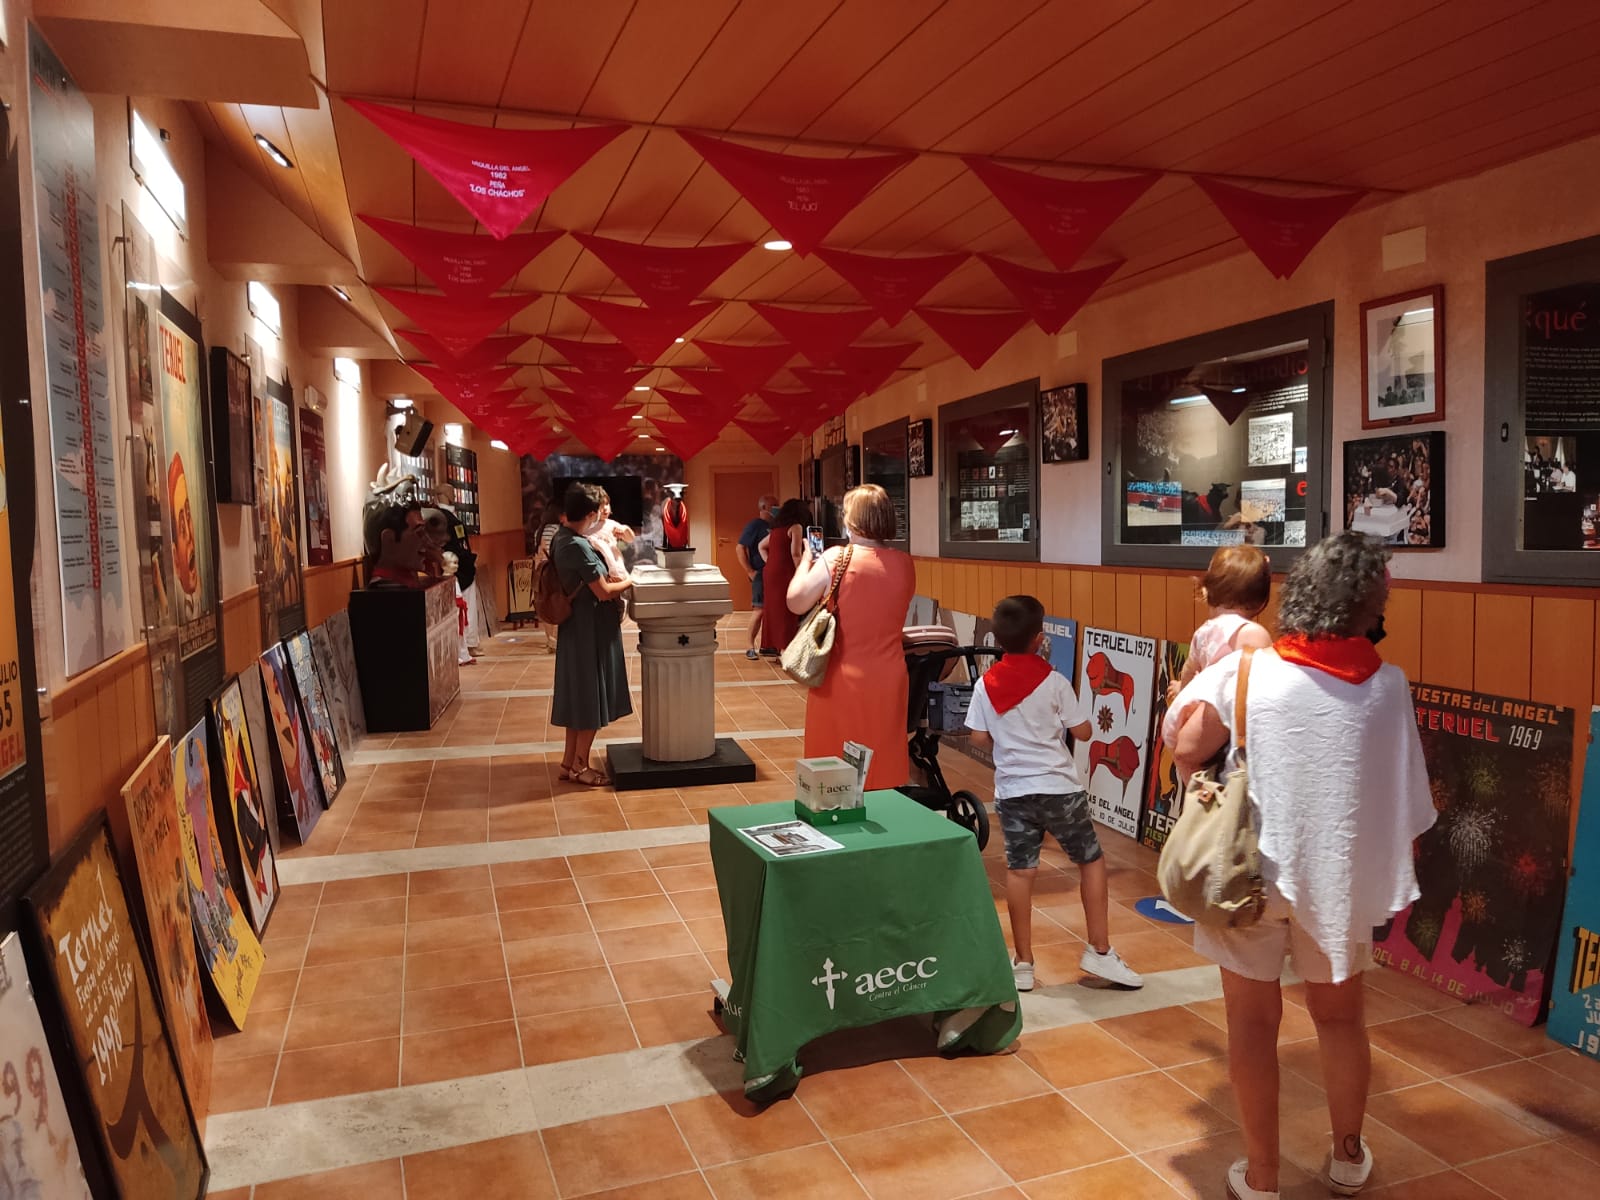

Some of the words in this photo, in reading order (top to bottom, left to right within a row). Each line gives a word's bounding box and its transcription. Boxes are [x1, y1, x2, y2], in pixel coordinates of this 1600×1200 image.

[1086, 631, 1133, 654] TERUEL
[1134, 641, 1153, 658] 1972
[1502, 702, 1559, 725] ANGEL
[1416, 707, 1501, 742] TERUEL
[1508, 725, 1543, 749] 1969
[826, 784, 852, 793] aecc
[1099, 798, 1110, 811] DEL
[1114, 805, 1135, 821] ANGEL
[1118, 820, 1135, 833] JULIO
[855, 956, 938, 995] aecc
[1373, 947, 1394, 966] DEL
[1413, 964, 1427, 980] AL
[1432, 973, 1443, 986] 14
[1447, 979, 1466, 996] DE
[869, 991, 892, 1002] Contra
[894, 986, 900, 995] el
[1582, 994, 1592, 1009] 2
